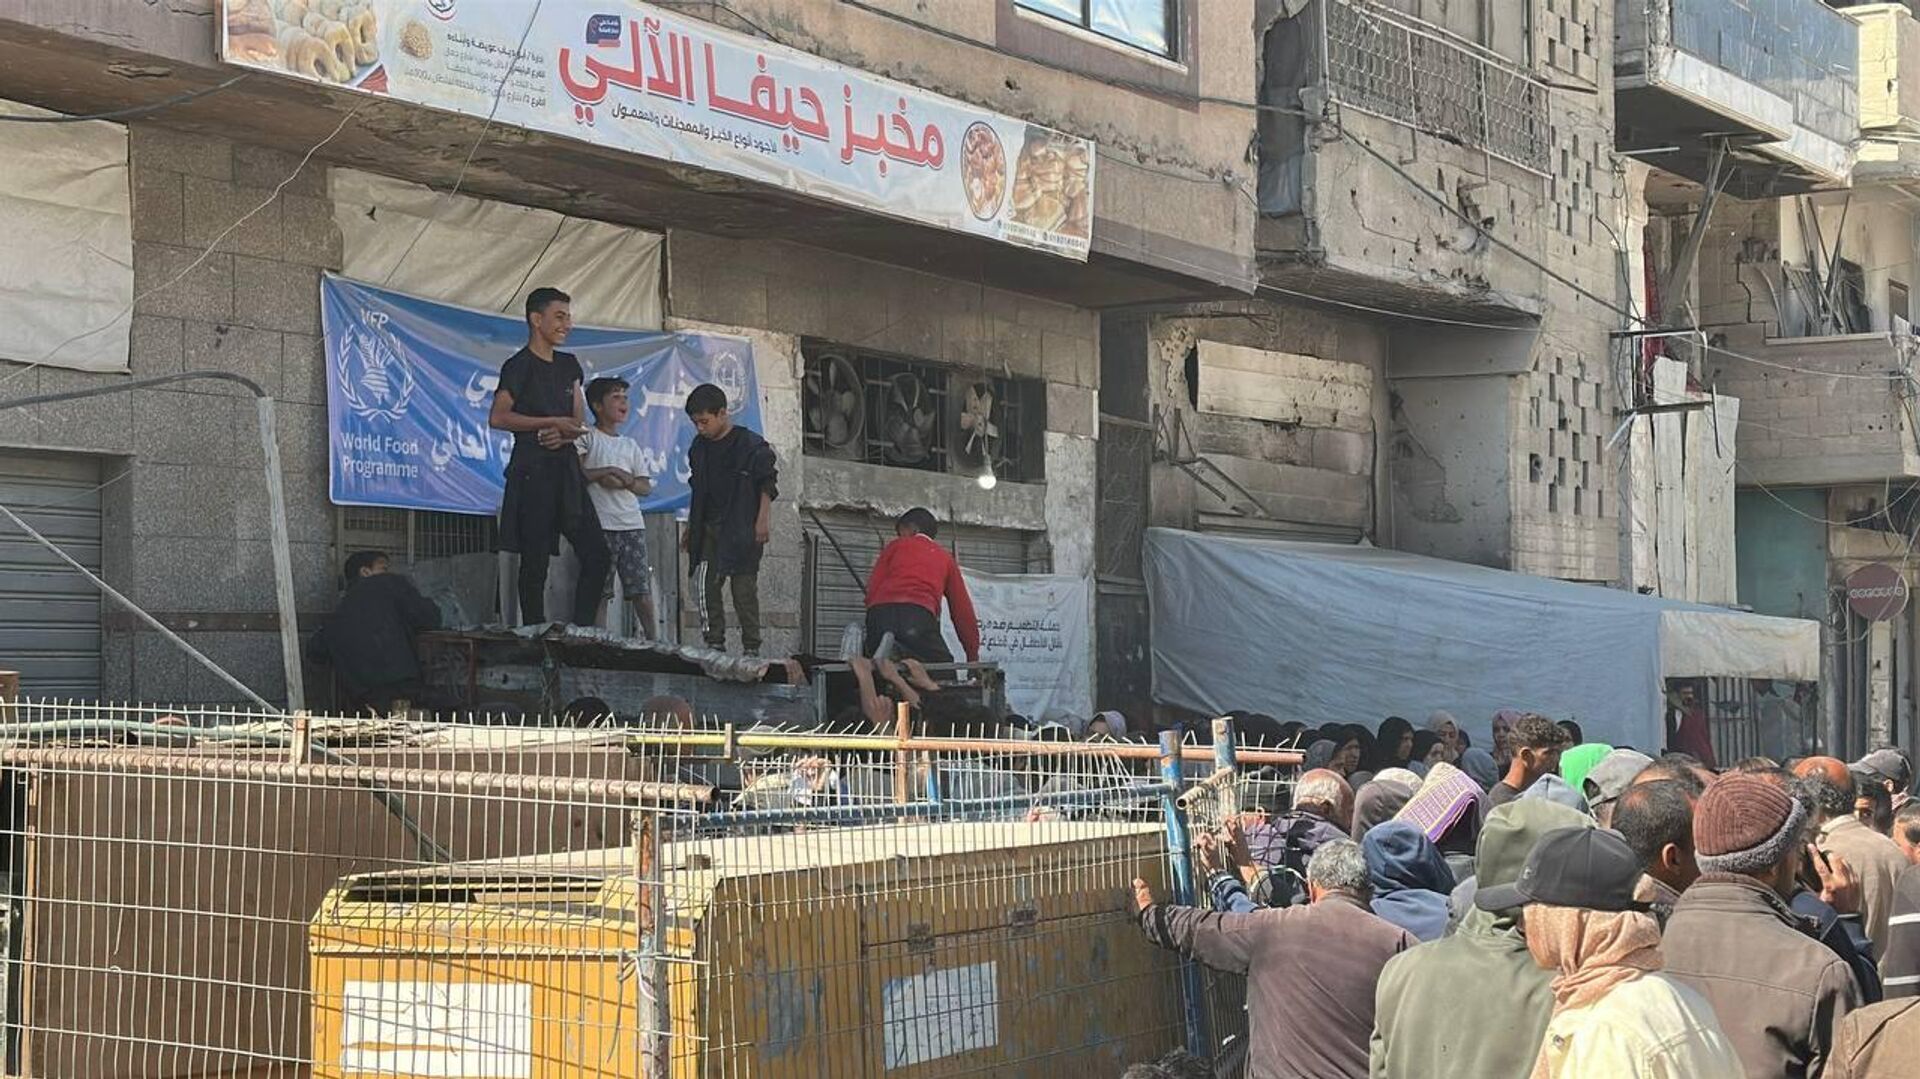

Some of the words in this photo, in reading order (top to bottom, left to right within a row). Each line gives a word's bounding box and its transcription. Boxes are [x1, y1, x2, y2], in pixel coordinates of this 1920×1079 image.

[558, 17, 696, 126] الآلي
[704, 41, 830, 152] حيفا
[661, 114, 710, 140] والمعجنات
[711, 129, 733, 144] الخبز
[840, 84, 945, 175] مخبز
[734, 131, 753, 149] أنواع
[341, 432, 381, 454] World
[384, 436, 419, 456] Food
[342, 455, 419, 479] Programme
